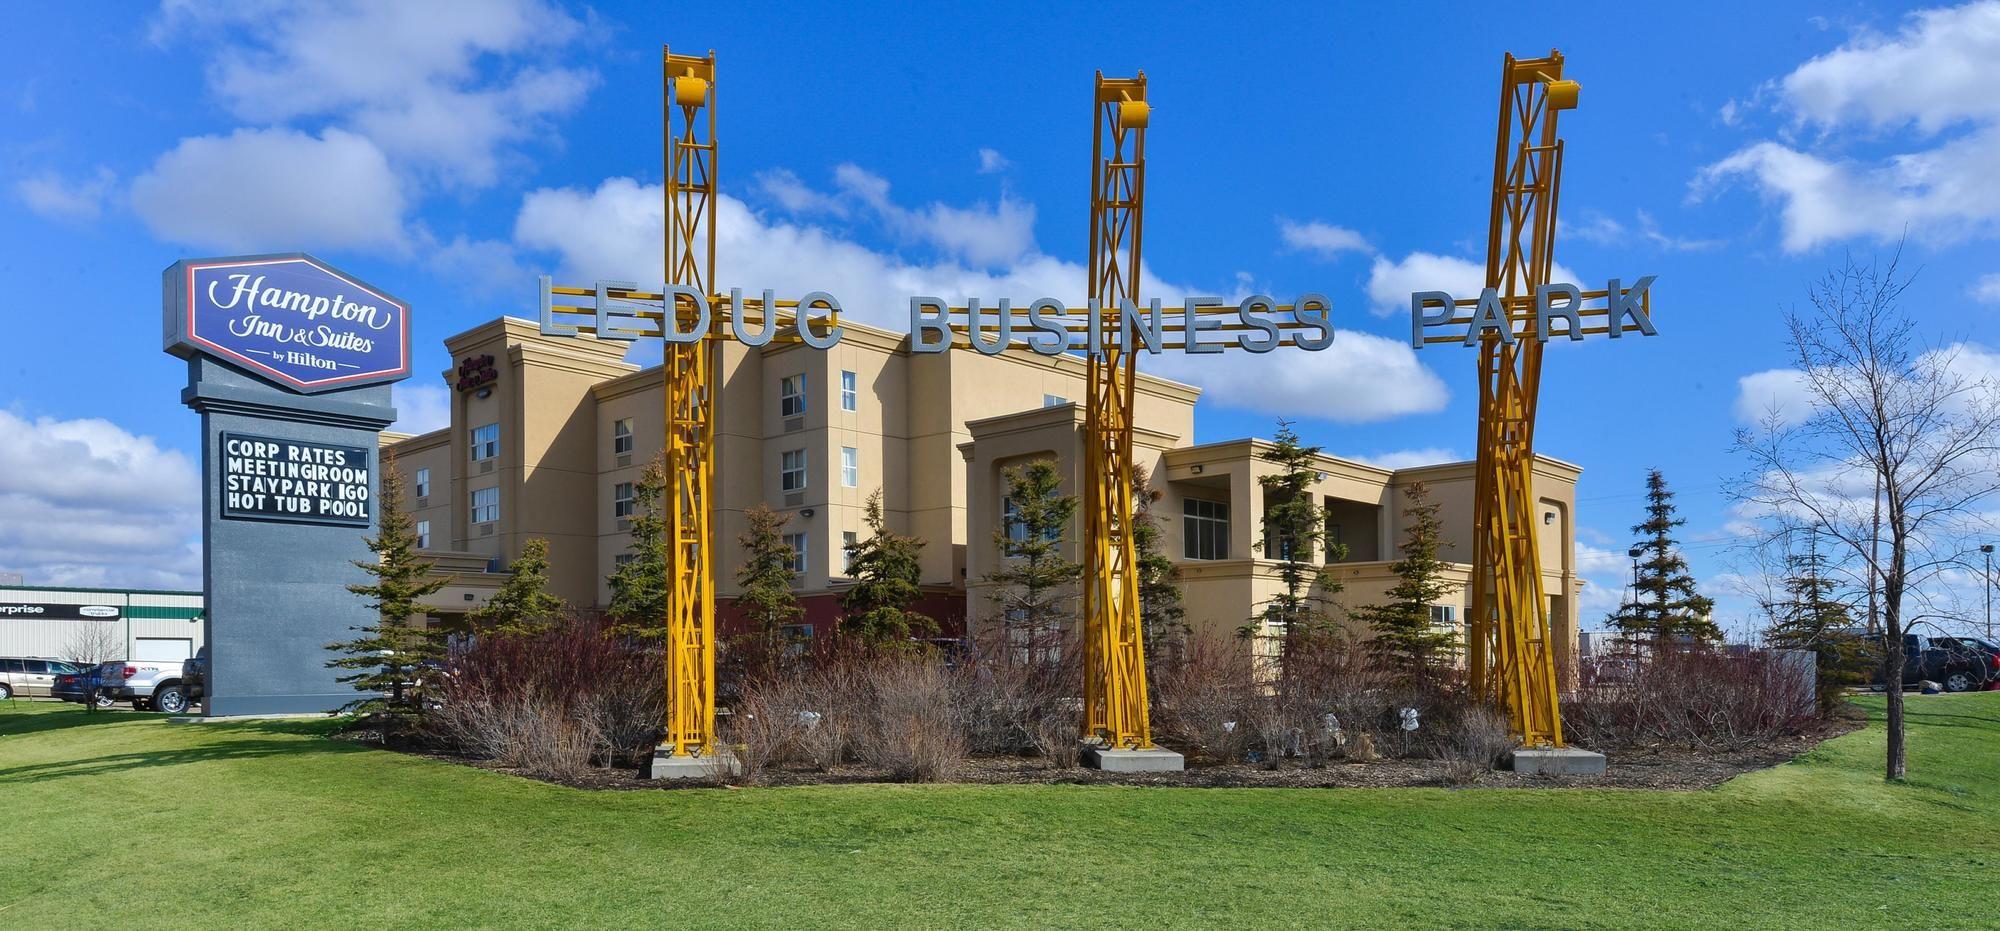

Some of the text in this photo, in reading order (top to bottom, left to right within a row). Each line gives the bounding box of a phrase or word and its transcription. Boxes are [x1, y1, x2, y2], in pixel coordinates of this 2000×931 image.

[208, 274, 391, 330] Hampton
[539, 274, 1659, 355] LEDUC BUSINESS PARK
[229, 315, 373, 353] Inn & Suites
[272, 350, 337, 370] by Hilton
[227, 439, 346, 466] CORP RATES
[228, 492, 368, 518] HOT TUB POOL
